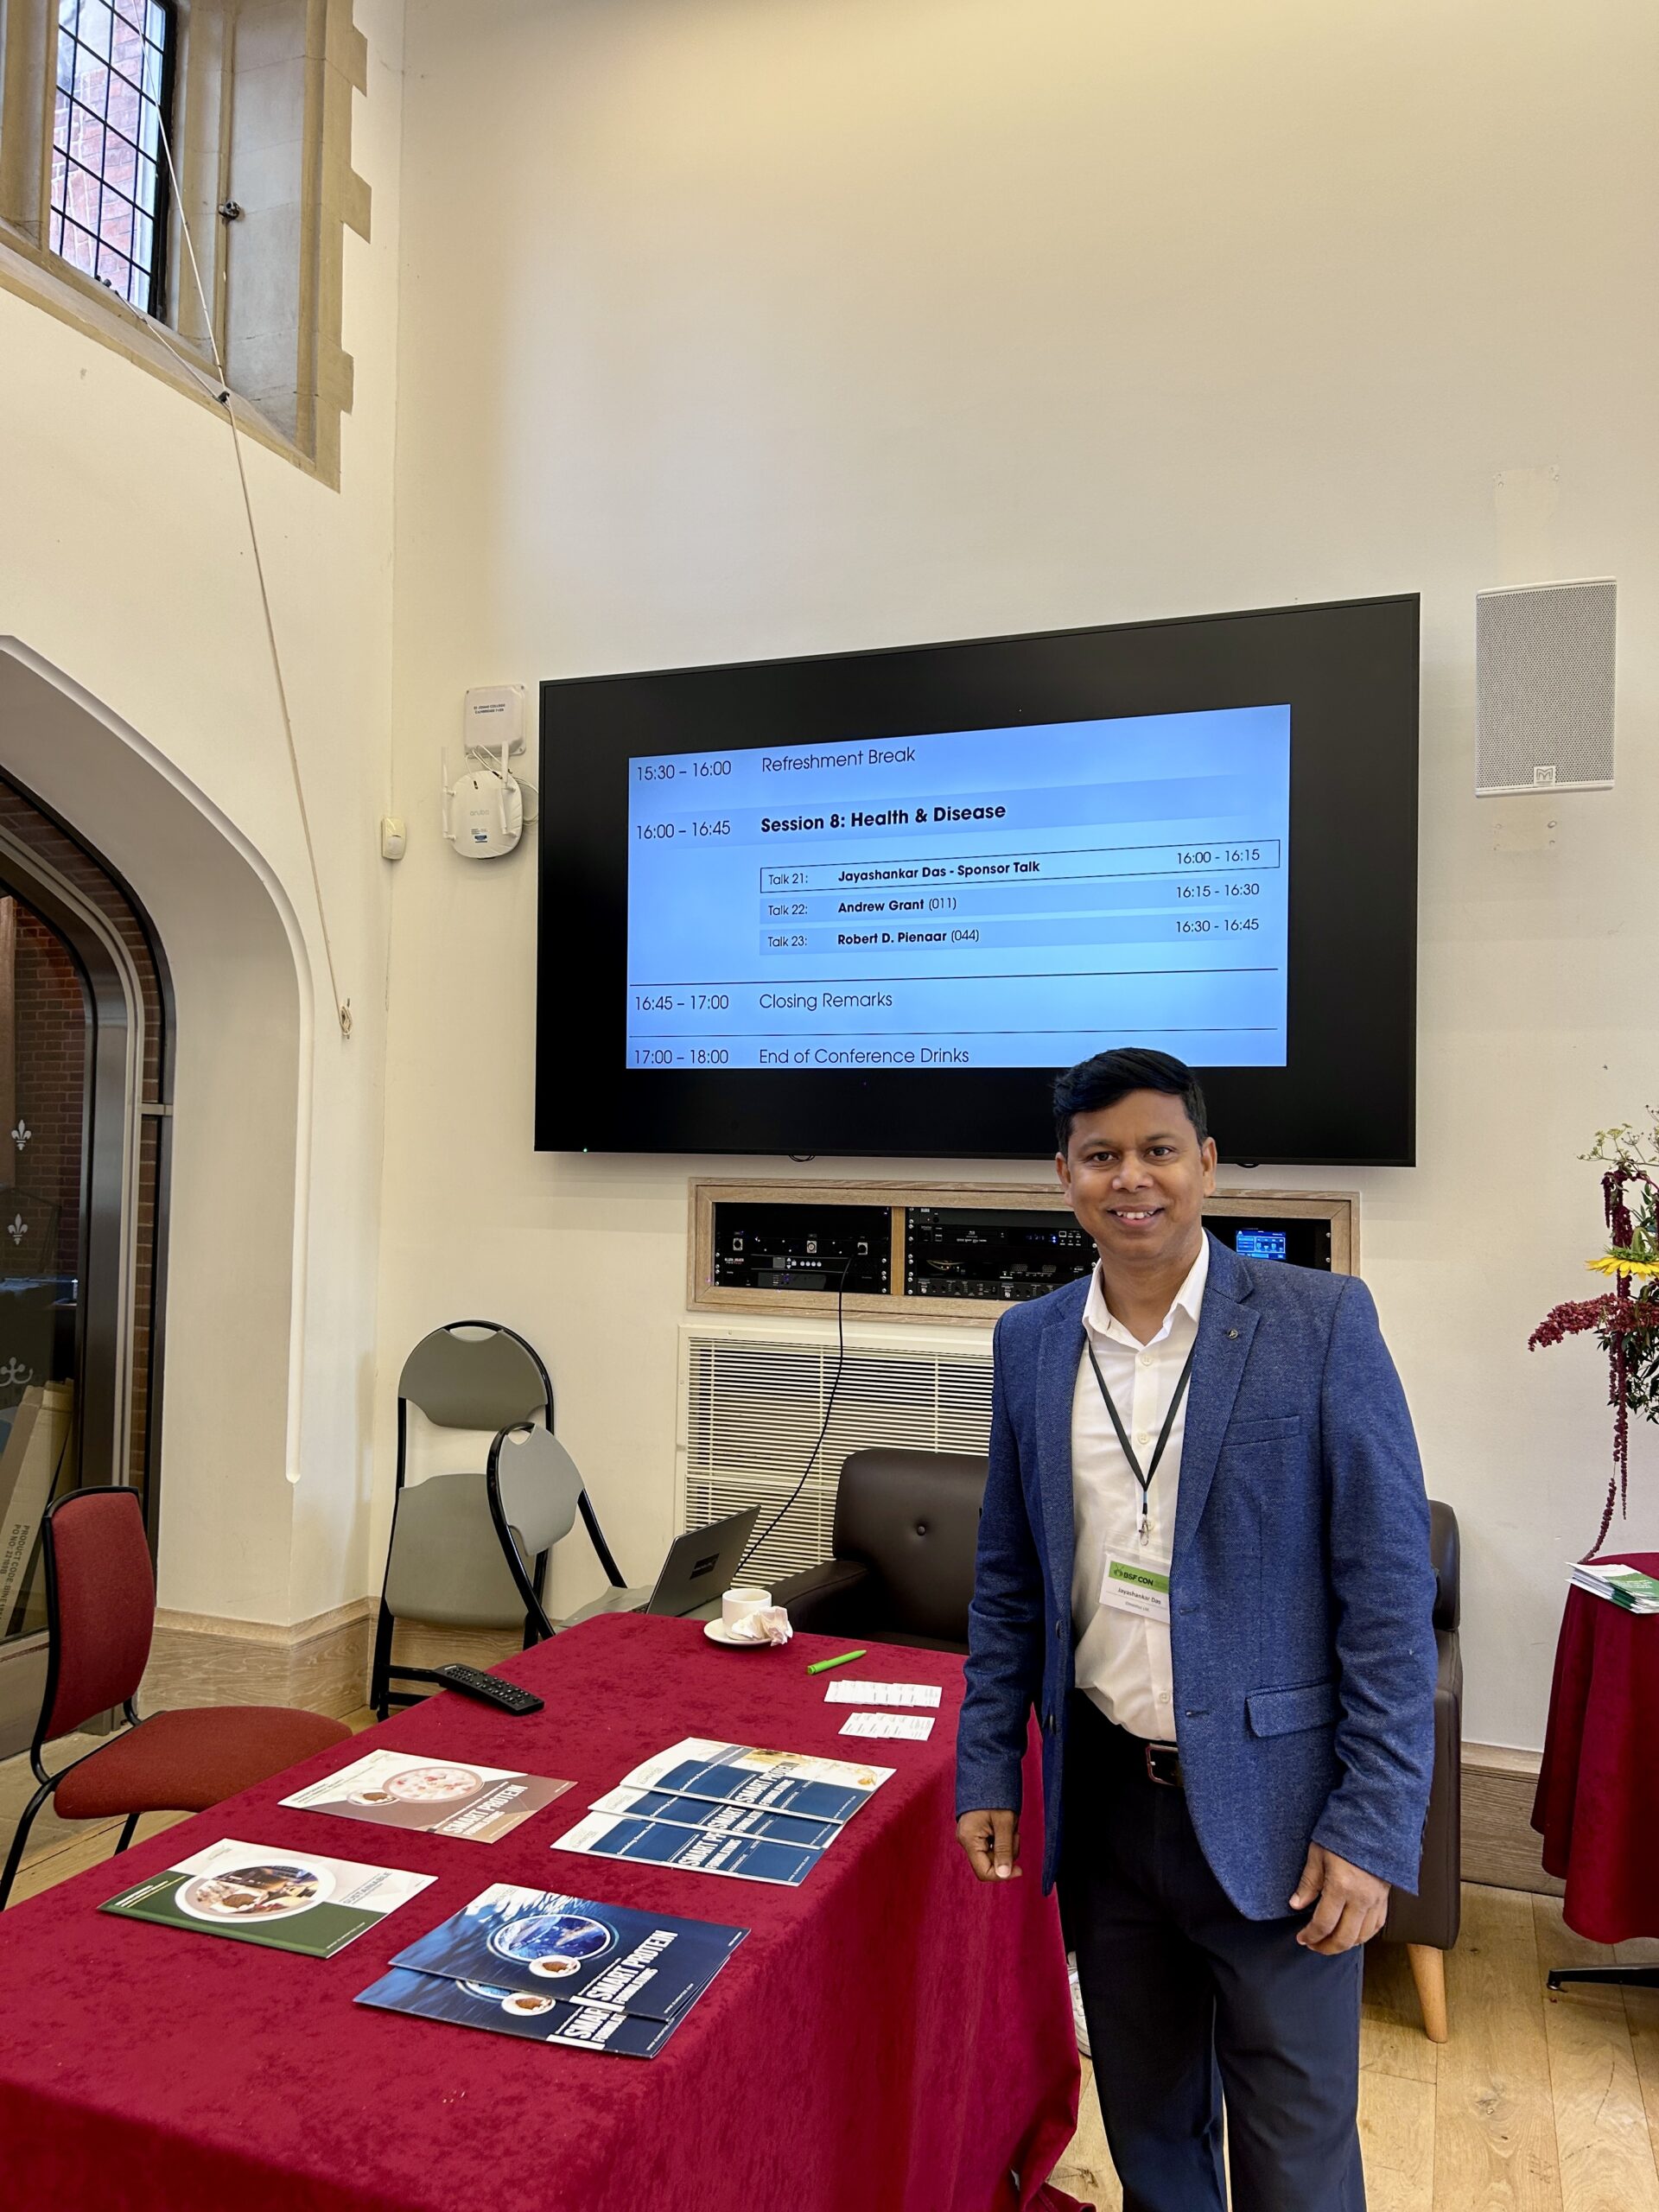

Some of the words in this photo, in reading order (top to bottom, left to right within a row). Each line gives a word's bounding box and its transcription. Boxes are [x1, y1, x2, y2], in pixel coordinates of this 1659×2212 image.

[762, 750, 864, 772] Refreshment
[868, 746, 916, 765] Break
[638, 764, 676, 781] 15:30
[693, 760, 732, 778] 16:00
[760, 815, 824, 833] Session
[830, 813, 846, 829] 8:
[850, 809, 909, 828] Health
[914, 807, 928, 823] &
[933, 805, 1007, 823] Disease
[637, 823, 675, 840] 16:00
[692, 820, 731, 837] 16:45
[1177, 850, 1212, 865] 16:00
[1224, 849, 1261, 862] 16:15
[767, 874, 790, 886] Talk
[791, 873, 809, 885] 21:
[837, 868, 919, 884] Jayashankar
[921, 866, 947, 878] Das
[957, 864, 1011, 879] Sponsor
[1013, 861, 1040, 874] Talk
[1176, 885, 1211, 899] 16:15
[1224, 882, 1260, 897] 16:30
[767, 904, 790, 916] Talk
[791, 903, 808, 915] 22:
[837, 901, 886, 913] Andrew
[888, 899, 925, 912] Grant
[928, 897, 957, 912] (011)
[1176, 919, 1211, 933] 16:30
[1224, 918, 1260, 931] 16:45
[767, 936, 789, 948] Talk
[791, 935, 808, 947] 23:
[837, 932, 879, 945] Robert
[881, 932, 894, 944] D.
[897, 931, 948, 944] Pienaar
[950, 929, 980, 944] (044)
[635, 995, 673, 1011] 16:45
[690, 995, 729, 1010] 17:00
[759, 993, 817, 1012] Closing
[823, 991, 893, 1007] Remarks
[634, 1049, 673, 1065] 17:00
[690, 1049, 729, 1065] 18:00
[760, 1048, 789, 1064] End
[793, 1048, 810, 1064] of
[814, 1048, 915, 1064] Conference
[920, 1047, 969, 1063] Drinks
[14, 1524, 31, 1561] PRODUCT
[1137, 1576, 1154, 1586] CON
[734, 1777, 775, 1803] SMART
[442, 1808, 489, 1834] SMART
[476, 1783, 529, 1812] PROTEIN
[707, 1805, 747, 1830] SMART
[677, 1839, 719, 1867] SMART
[586, 1963, 640, 2001] SMART
[620, 1929, 678, 1969] PROTEIN
